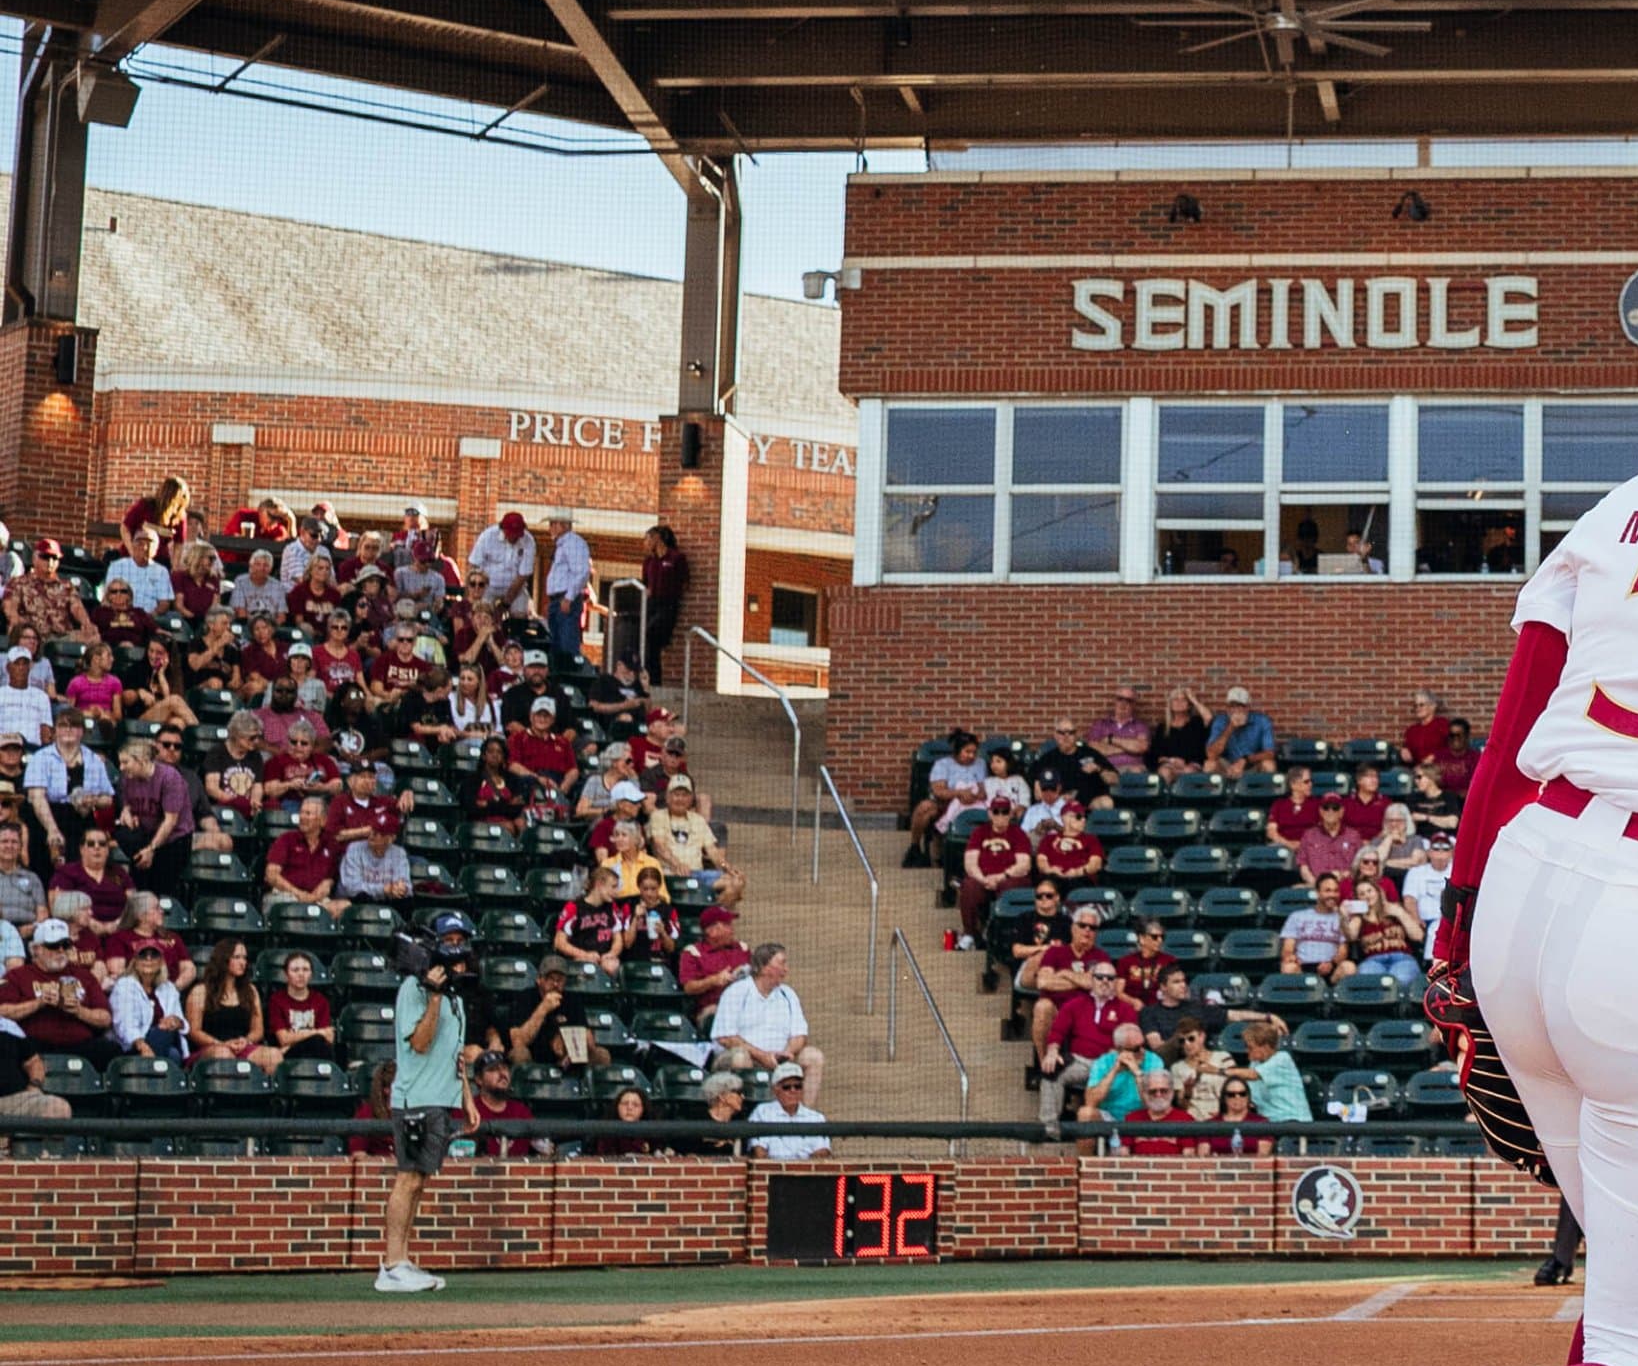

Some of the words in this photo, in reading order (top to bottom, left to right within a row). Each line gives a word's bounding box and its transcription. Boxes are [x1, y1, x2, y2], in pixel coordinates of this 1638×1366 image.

[1071, 276, 1538, 350] SEMINOLE
[508, 411, 624, 450] PRICE
[790, 439, 856, 476] TEA
